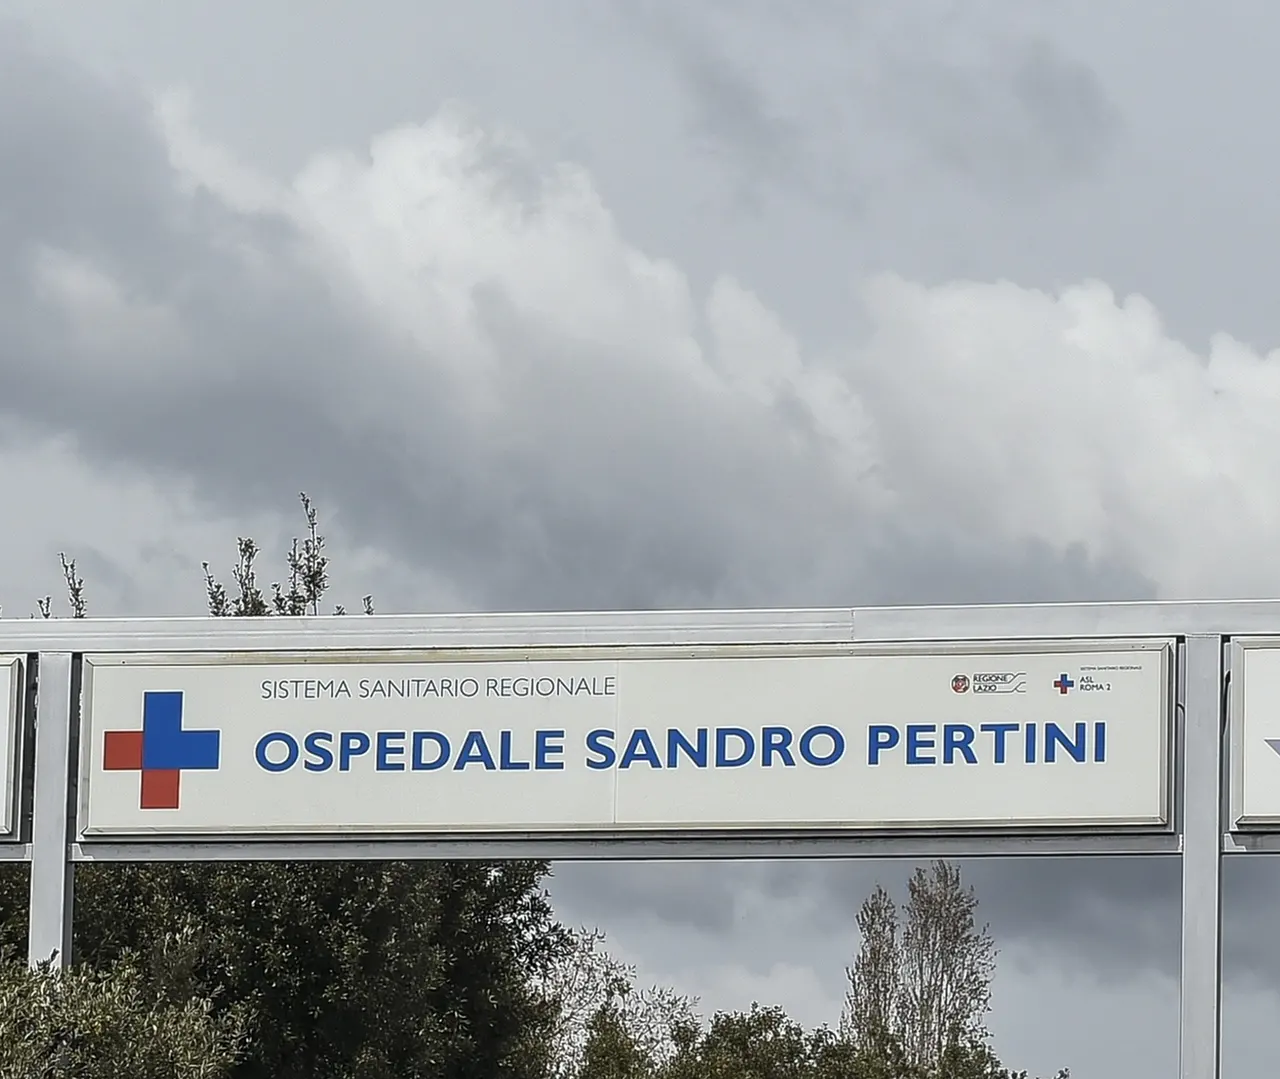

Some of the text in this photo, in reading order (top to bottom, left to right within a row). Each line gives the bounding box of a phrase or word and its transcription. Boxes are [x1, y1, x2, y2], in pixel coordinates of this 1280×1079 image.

[261, 676, 616, 699] SISTEMA SANITARIO REGIONALE
[973, 684, 997, 692] LAZIO
[1080, 683, 1105, 691] ROMA
[255, 722, 1106, 773] OSPEDALE SANDRO PERTINI
